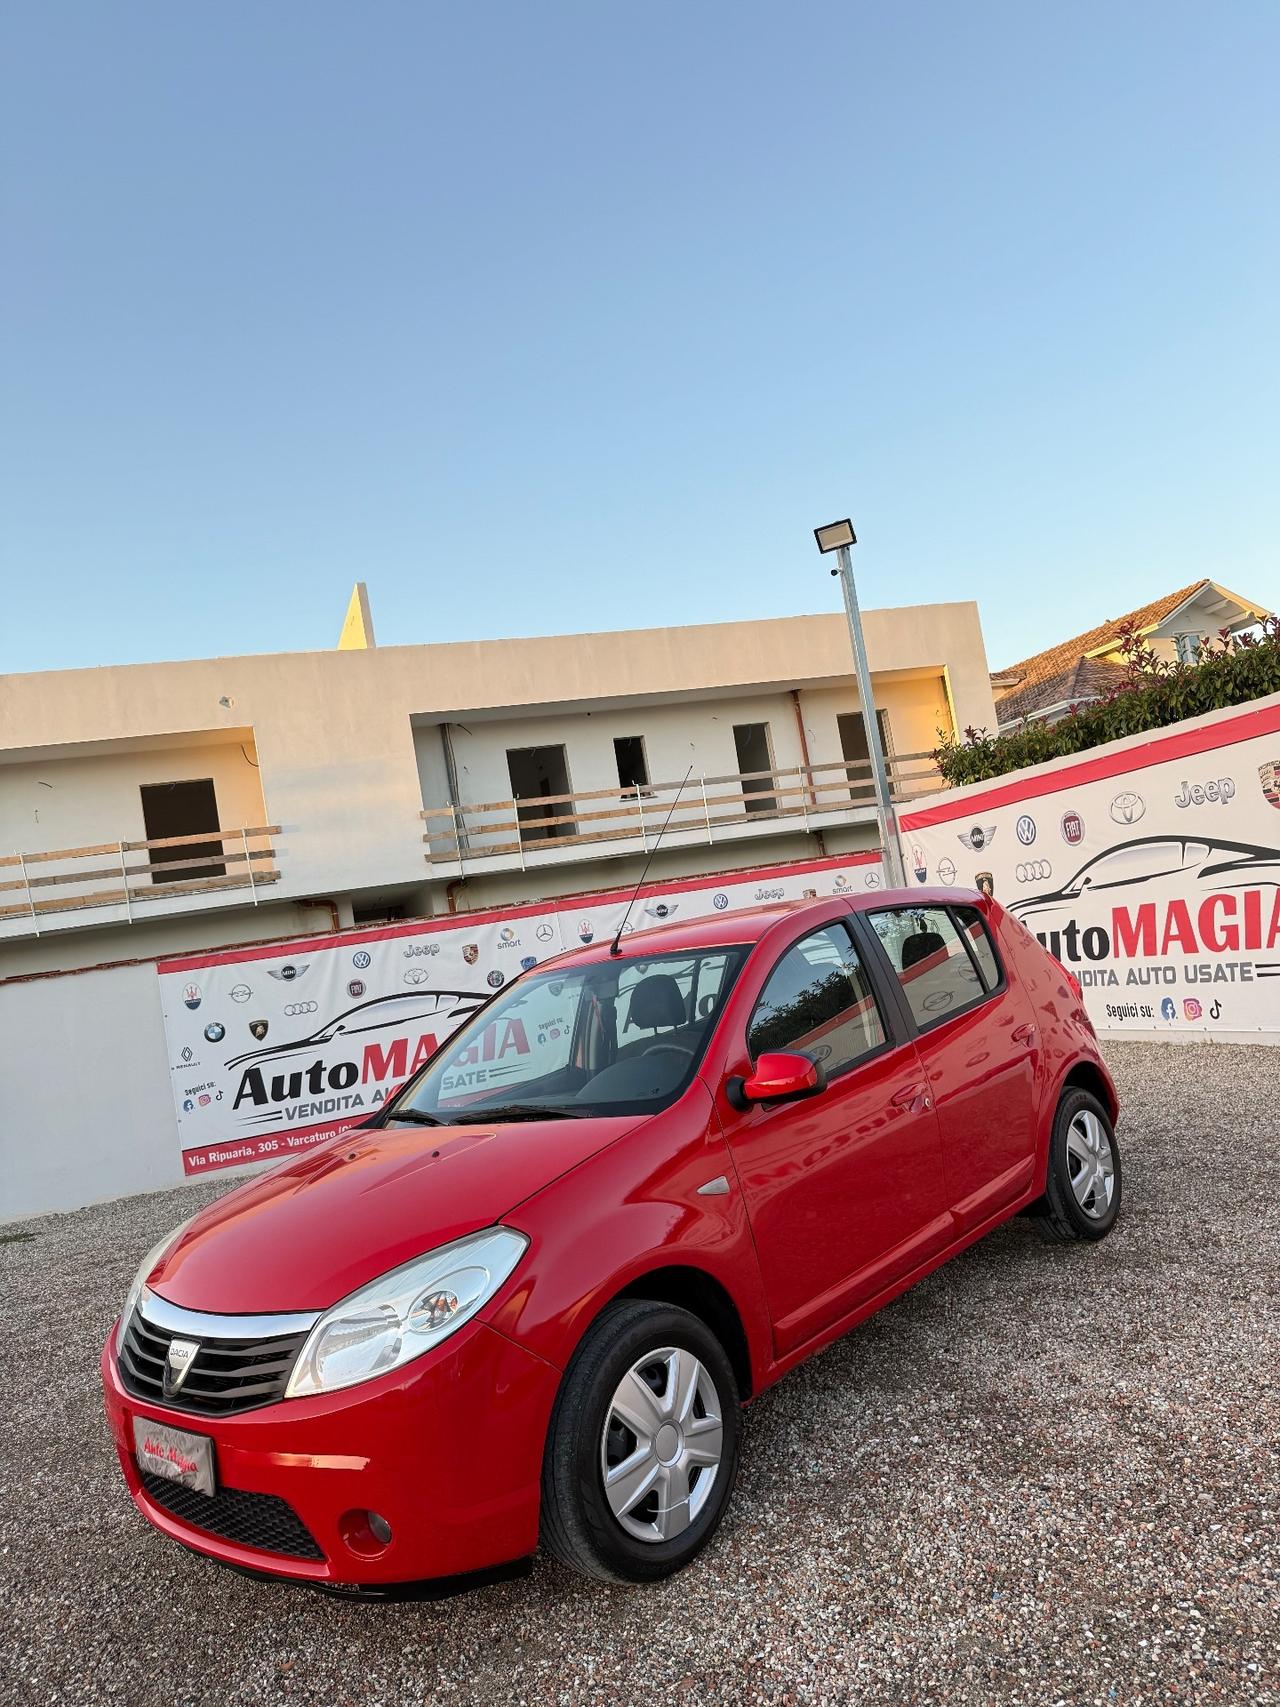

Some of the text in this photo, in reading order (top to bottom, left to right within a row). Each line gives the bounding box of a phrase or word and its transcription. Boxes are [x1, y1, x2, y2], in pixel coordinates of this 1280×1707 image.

[1175, 777, 1235, 808] Jeep
[1065, 820, 1080, 838] FIAT
[754, 887, 785, 901] Jeep
[832, 885, 853, 895] smart
[1021, 888, 1280, 962] utoMAGI
[403, 943, 440, 958] Jeep
[497, 939, 521, 950] smart
[1126, 966, 1177, 986] AUTO
[1184, 962, 1253, 984] USATE
[1106, 1002, 1138, 1021] Seguici
[1140, 1005, 1155, 1018] su:
[176, 1061, 201, 1070] RENAULT
[184, 1081, 216, 1096] Seguici su:
[442, 1069, 488, 1090] SATE
[285, 1093, 364, 1120] VENDITA
[188, 1155, 206, 1167] Via
[209, 1146, 255, 1163] Ripuaria,
[258, 1140, 279, 1153] 305
[287, 1130, 337, 1147] Varcaturo
[170, 1347, 189, 1358] DACIA
[144, 1437, 164, 1457] Auto
